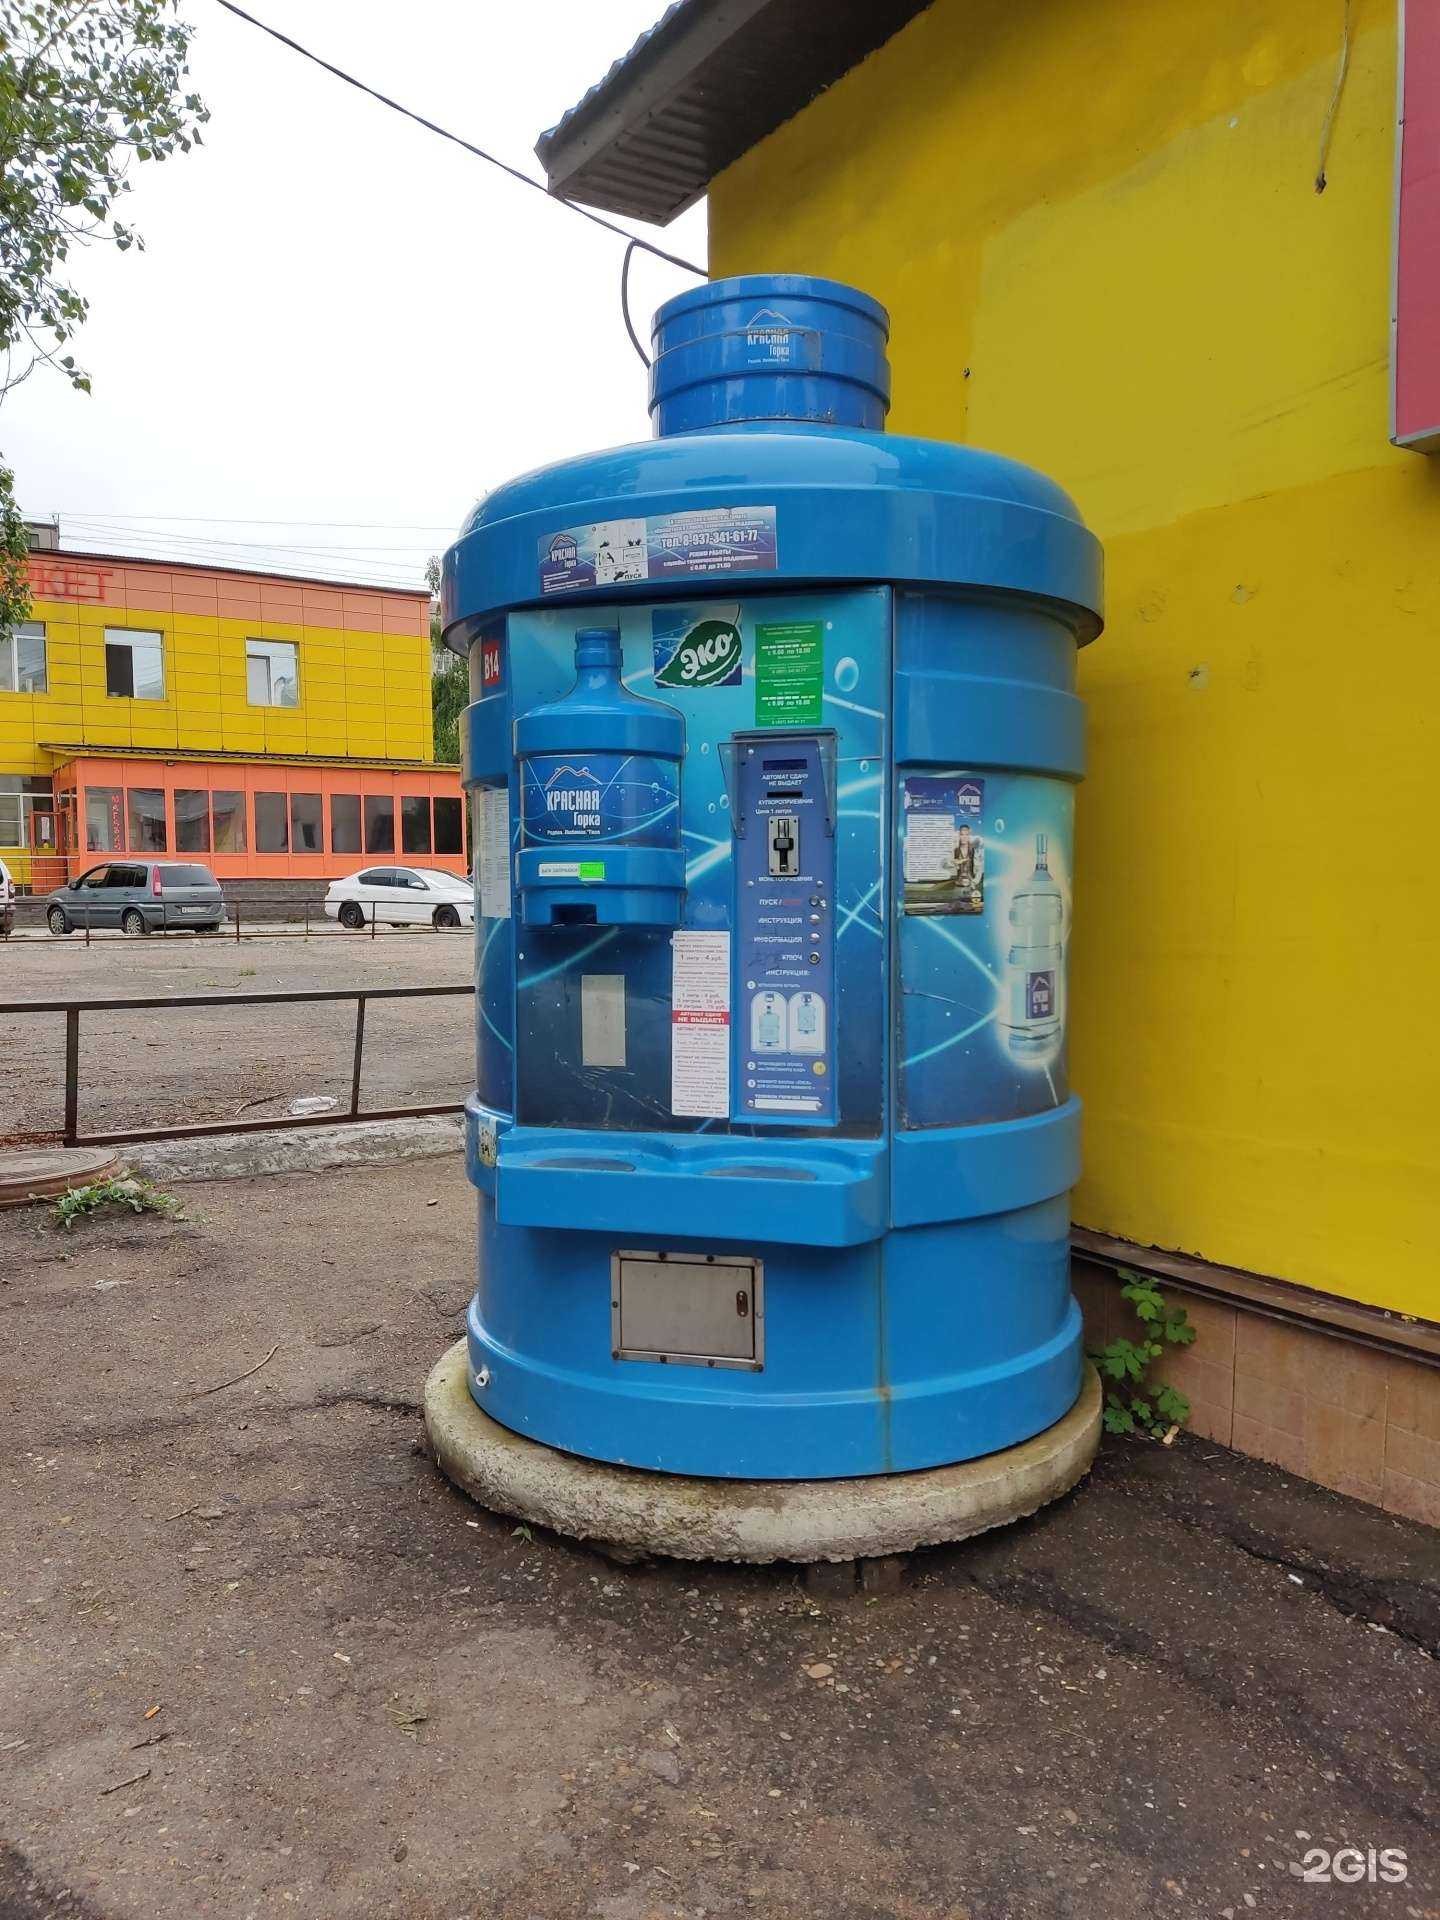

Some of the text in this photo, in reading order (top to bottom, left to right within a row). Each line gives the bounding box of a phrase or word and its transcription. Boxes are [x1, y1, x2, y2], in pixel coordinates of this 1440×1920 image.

[546, 789, 600, 811] КРАСНАЯ
[573, 811, 601, 829] Горка
[759, 898, 778, 906] ПУСК
